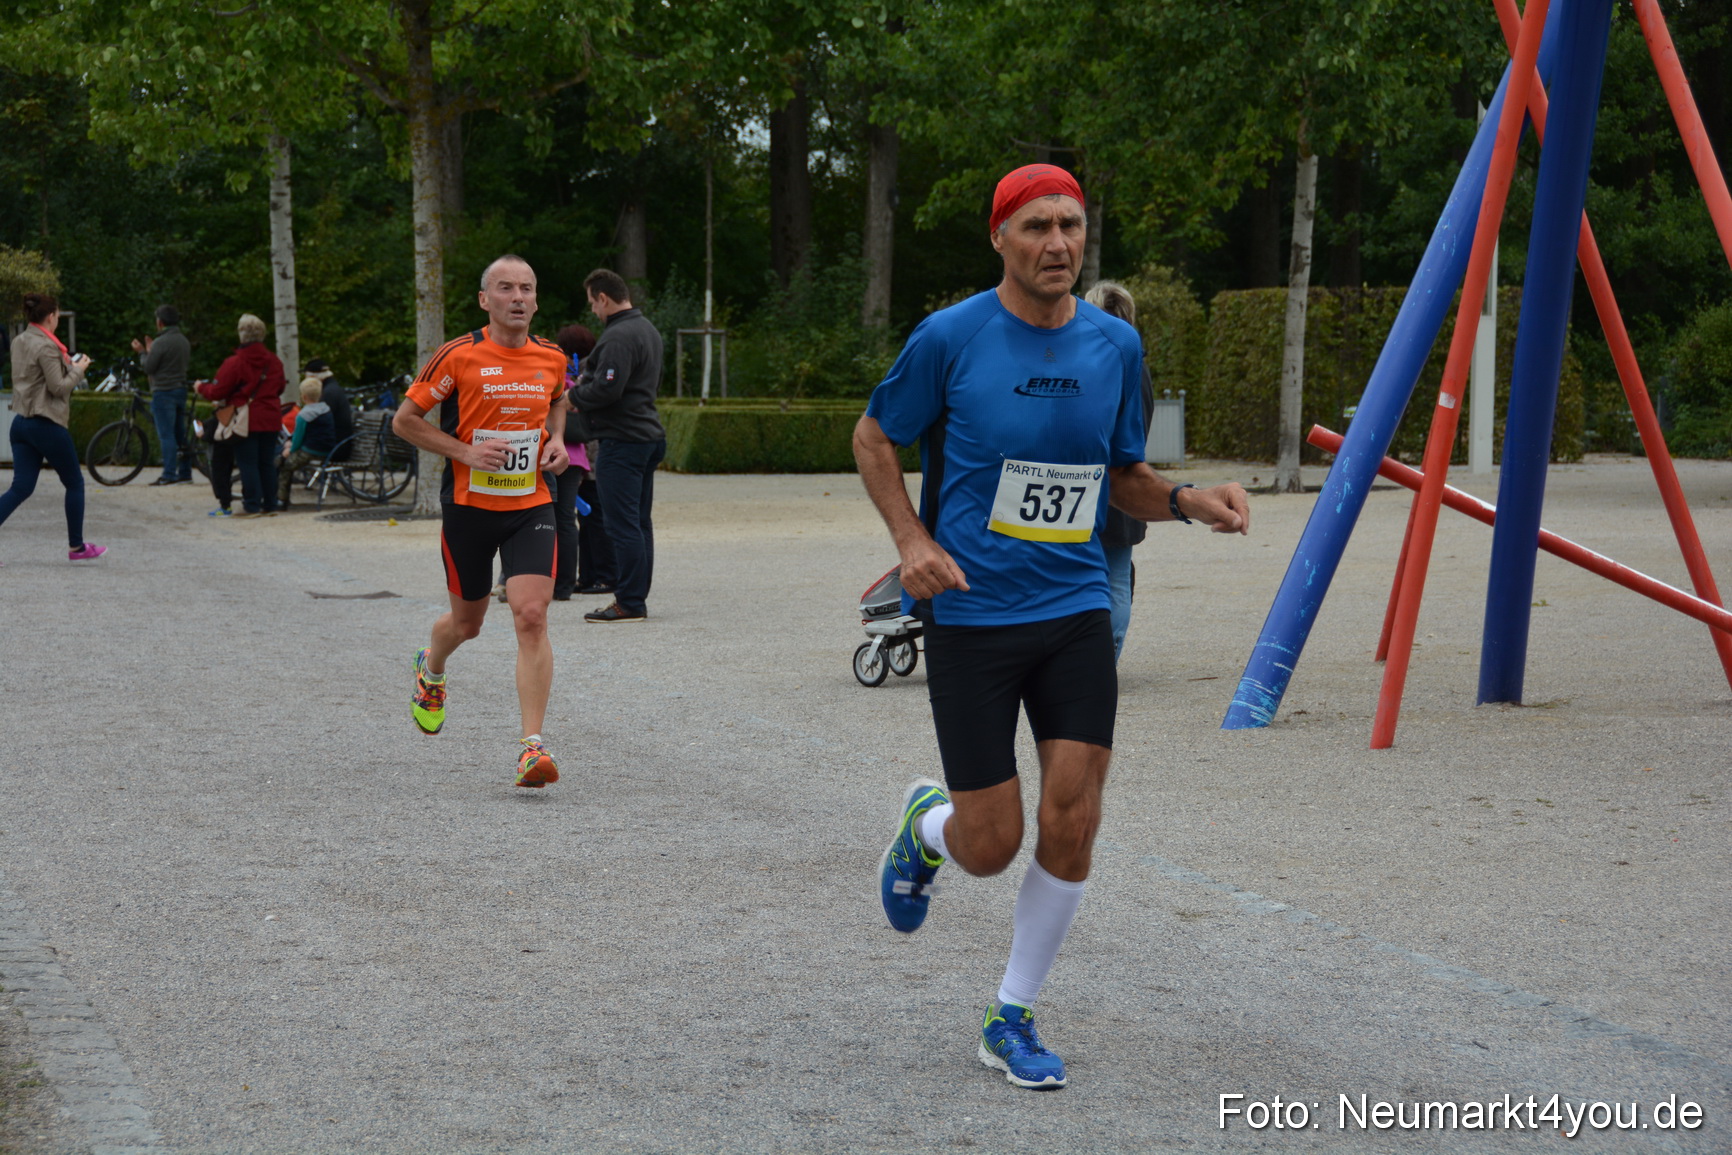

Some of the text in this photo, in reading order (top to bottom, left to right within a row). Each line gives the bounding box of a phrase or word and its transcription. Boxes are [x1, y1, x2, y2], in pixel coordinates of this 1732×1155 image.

[480, 366, 503, 376] DAK
[483, 382, 545, 394] SportScheck
[1026, 377, 1081, 389] ERTEL
[498, 447, 529, 472] 05
[1005, 463, 1092, 480] PARTL Neumarkt
[487, 476, 526, 487] Berthold
[1019, 483, 1087, 524] 537
